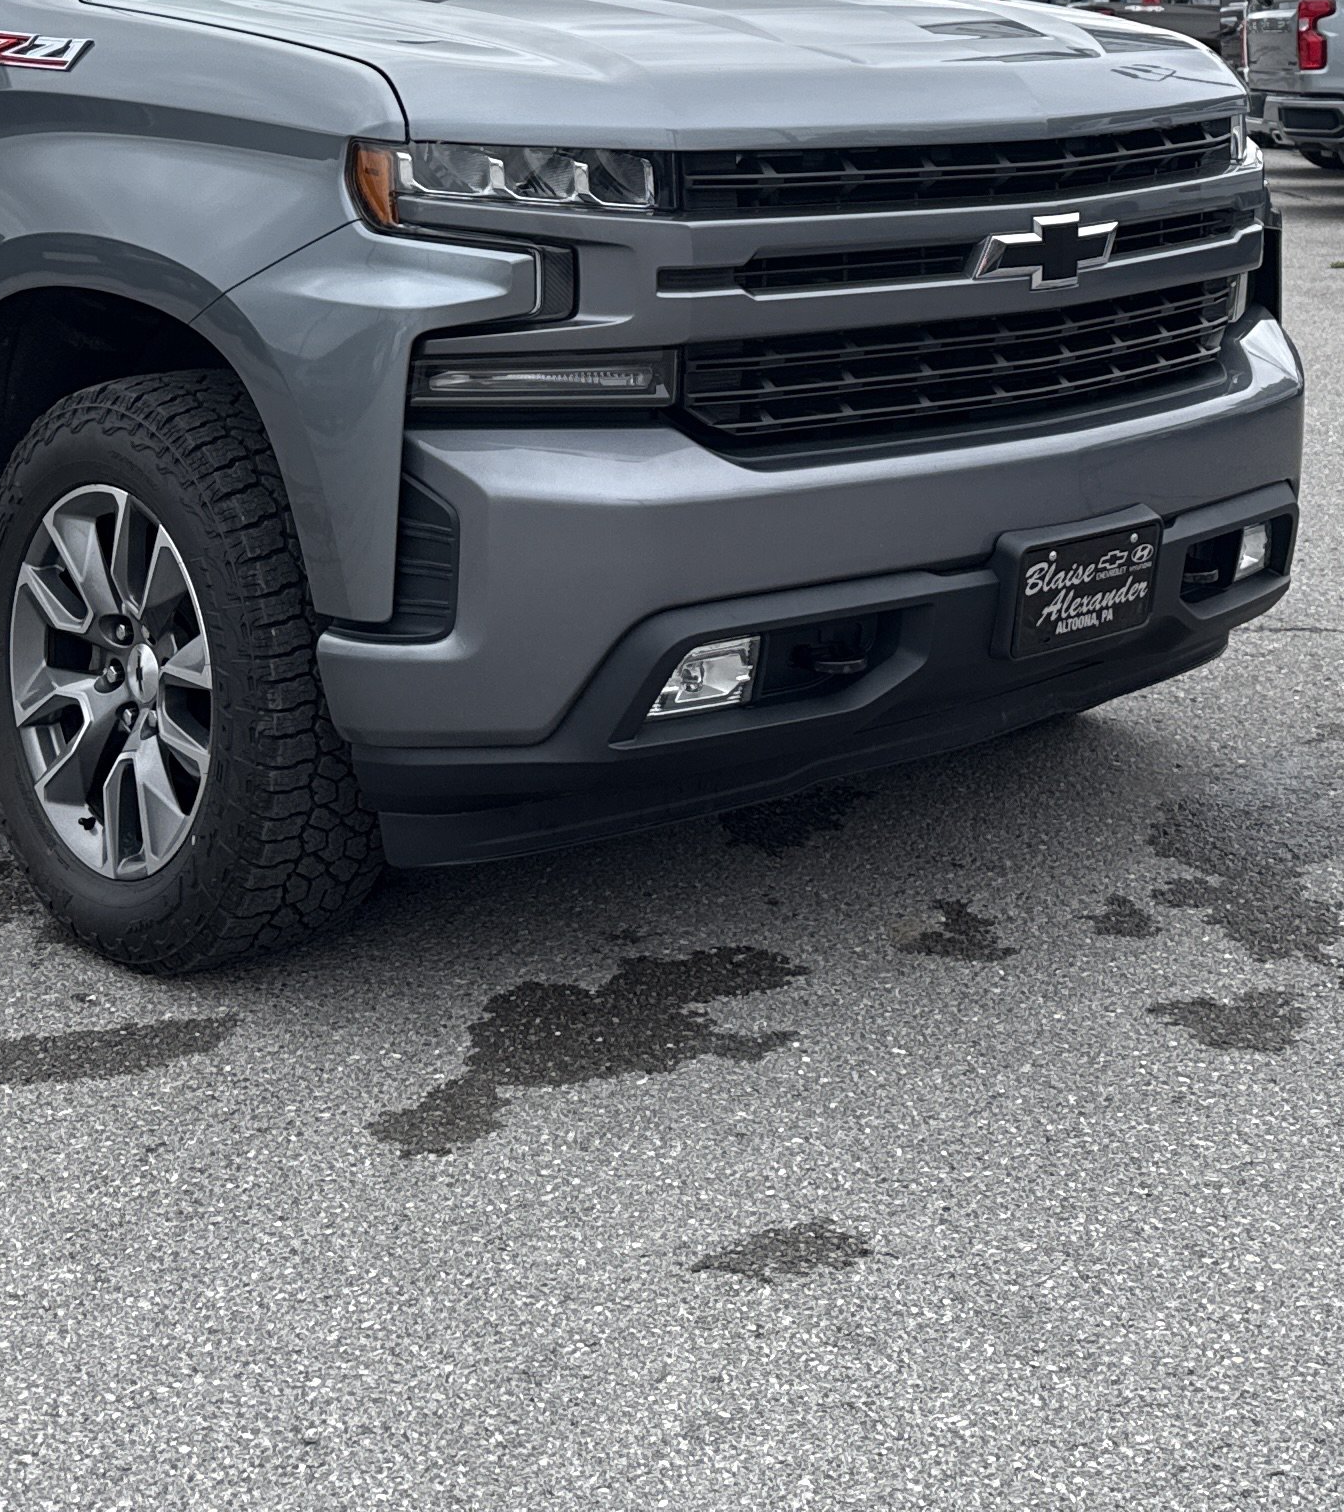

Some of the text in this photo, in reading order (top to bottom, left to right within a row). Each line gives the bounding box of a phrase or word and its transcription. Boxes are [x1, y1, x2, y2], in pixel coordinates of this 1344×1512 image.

[1024, 561, 1096, 596] Blaise
[1035, 575, 1149, 627] Alexander
[1055, 608, 1114, 635] ALTOONA, PA
